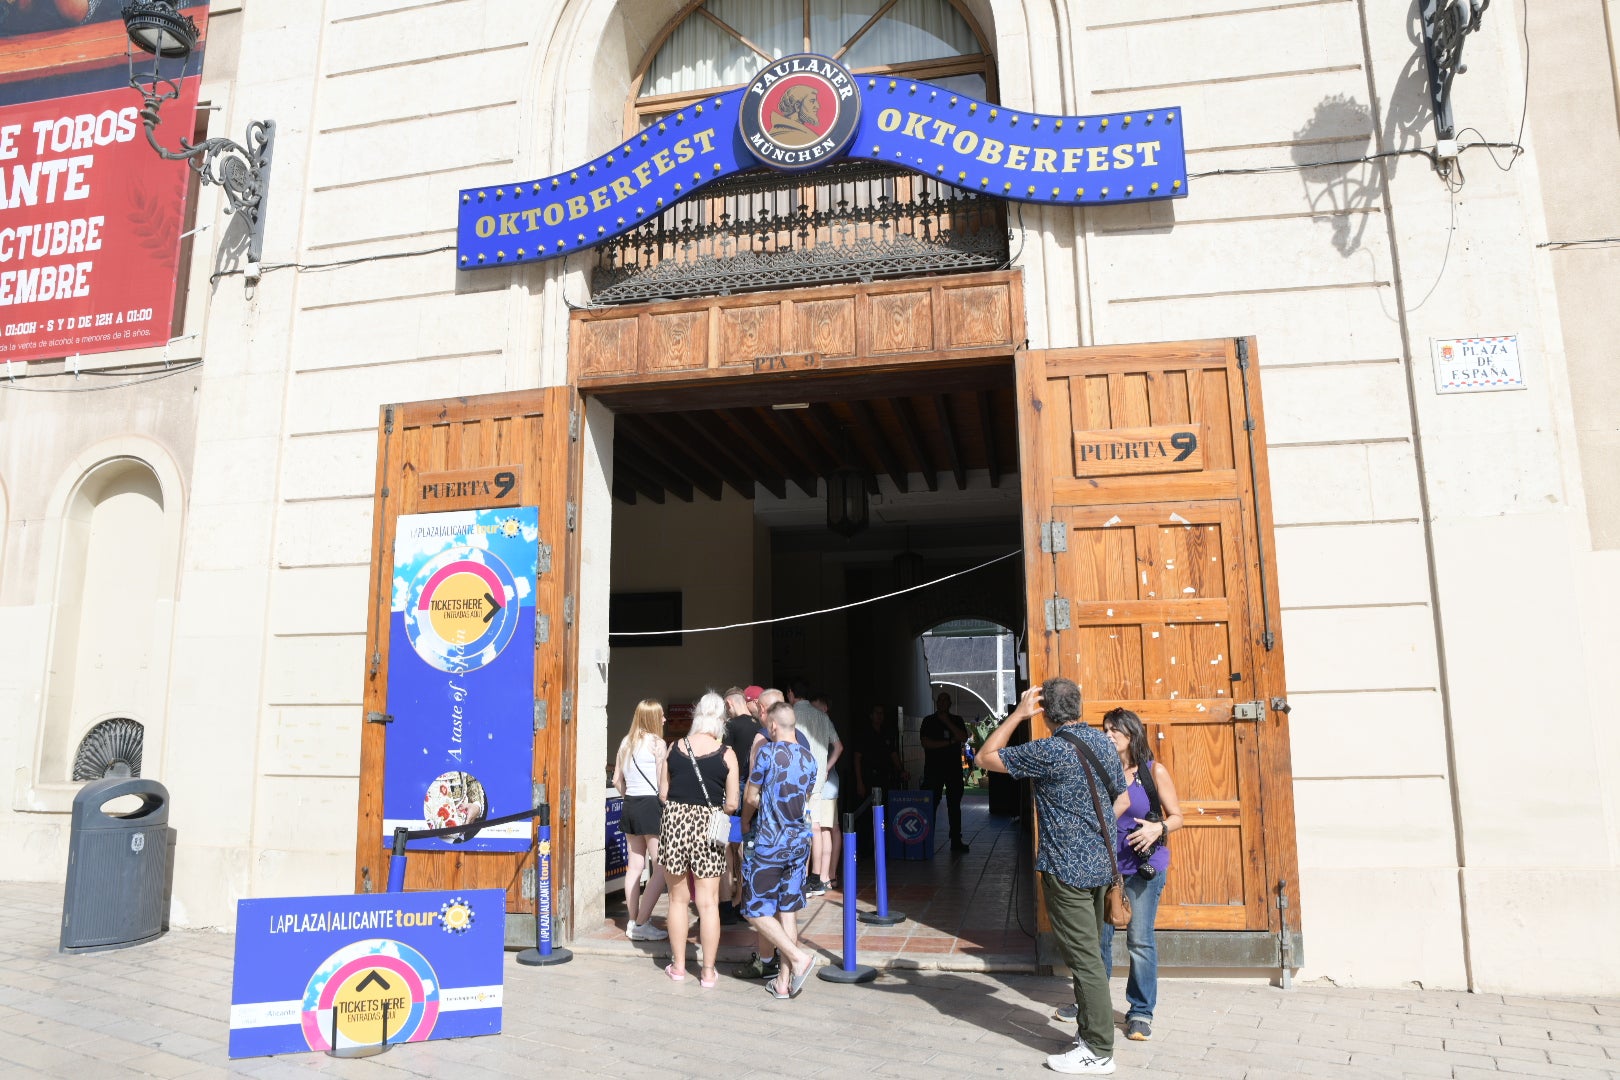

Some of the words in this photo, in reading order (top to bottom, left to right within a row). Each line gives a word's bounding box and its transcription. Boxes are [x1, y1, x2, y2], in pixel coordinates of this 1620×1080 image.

[752, 59, 853, 101] PAULANER
[33, 107, 138, 155] TOROS
[877, 108, 1161, 173] OKTOBERFEST
[750, 133, 836, 162] MÜNCHEN
[475, 128, 716, 238] OKTOBERFEST
[47, 320, 54, 331] S
[58, 319, 64, 330] Y
[67, 317, 75, 329] D
[78, 315, 92, 328] DE
[95, 313, 113, 326] 12H
[116, 312, 123, 323] A
[127, 308, 152, 322] 01:00
[49, 337, 73, 346] alcohol
[82, 334, 111, 343] menores
[113, 331, 121, 339] de
[124, 330, 130, 338] 18
[1462, 345, 1507, 356] PLAZA
[755, 356, 787, 371] PTA
[804, 354, 815, 367] 9
[1477, 357, 1493, 367] DE
[1451, 366, 1508, 380] ESPAÑA
[1080, 441, 1167, 462] PUERTA
[1170, 432, 1197, 462] 9
[422, 481, 490, 499] PUERTA
[494, 472, 515, 498] 9
[431, 600, 462, 610] TICKETS
[463, 599, 483, 609] HERE
[449, 681, 468, 702] of
[451, 706, 463, 743] taste
[448, 748, 462, 762] A
[395, 909, 438, 928] tour
[339, 1000, 379, 1014] TICKETS
[380, 997, 405, 1010] HERE
[347, 1012, 380, 1023] ENTRADAS
